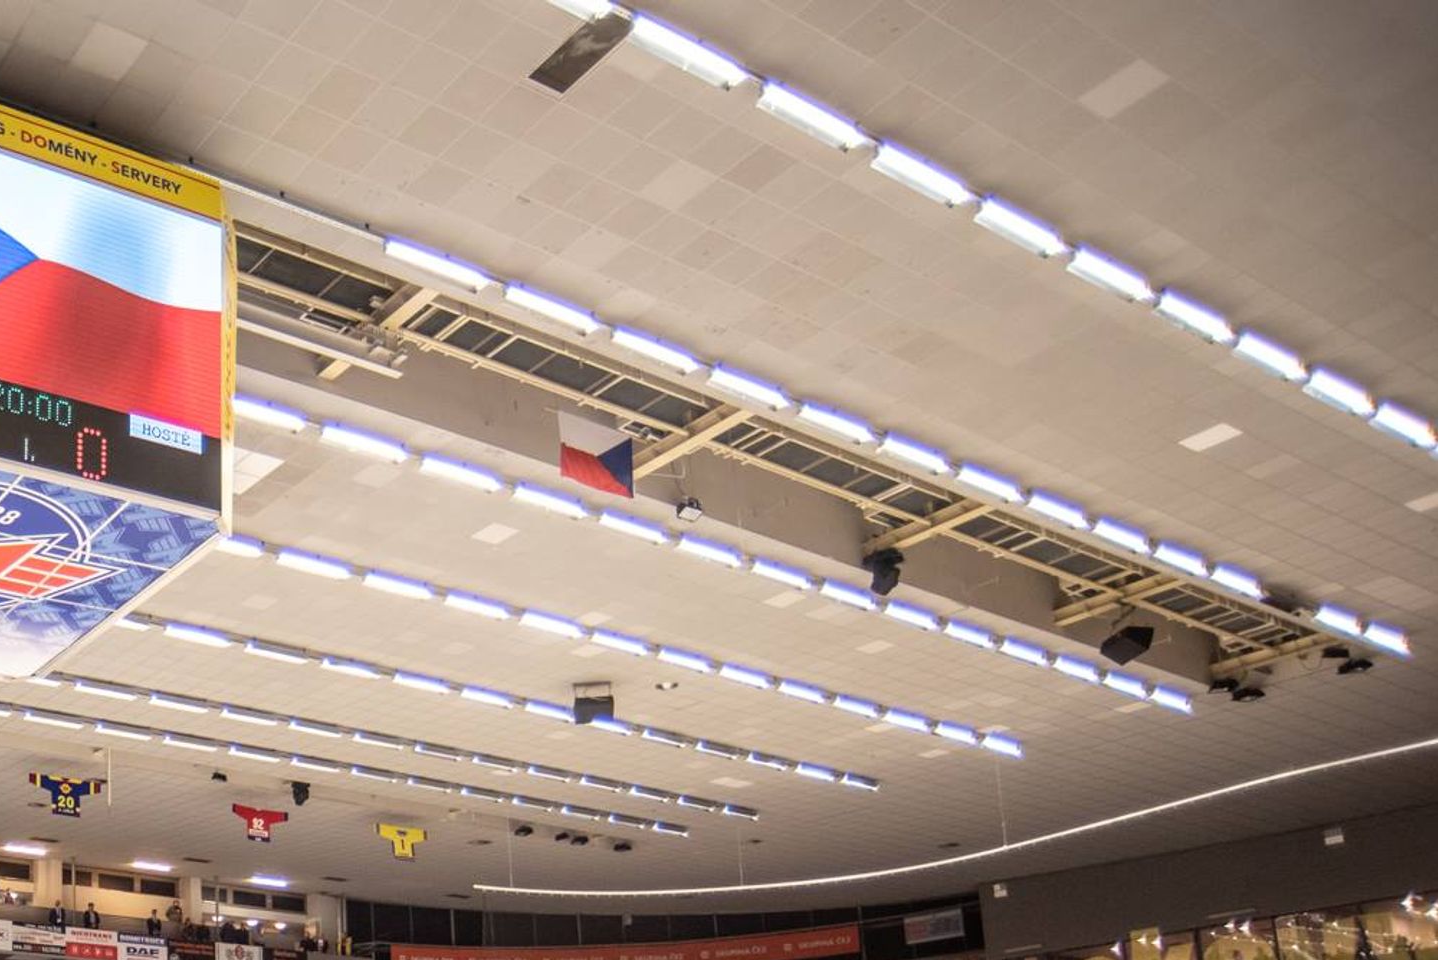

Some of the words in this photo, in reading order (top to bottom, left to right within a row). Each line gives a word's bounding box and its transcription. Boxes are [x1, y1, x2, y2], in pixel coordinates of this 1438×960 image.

[21, 129, 98, 166] DOMÉNY
[112, 160, 181, 195] SERVERY
[77, 427, 107, 481] 0
[57, 795, 75, 809] 20
